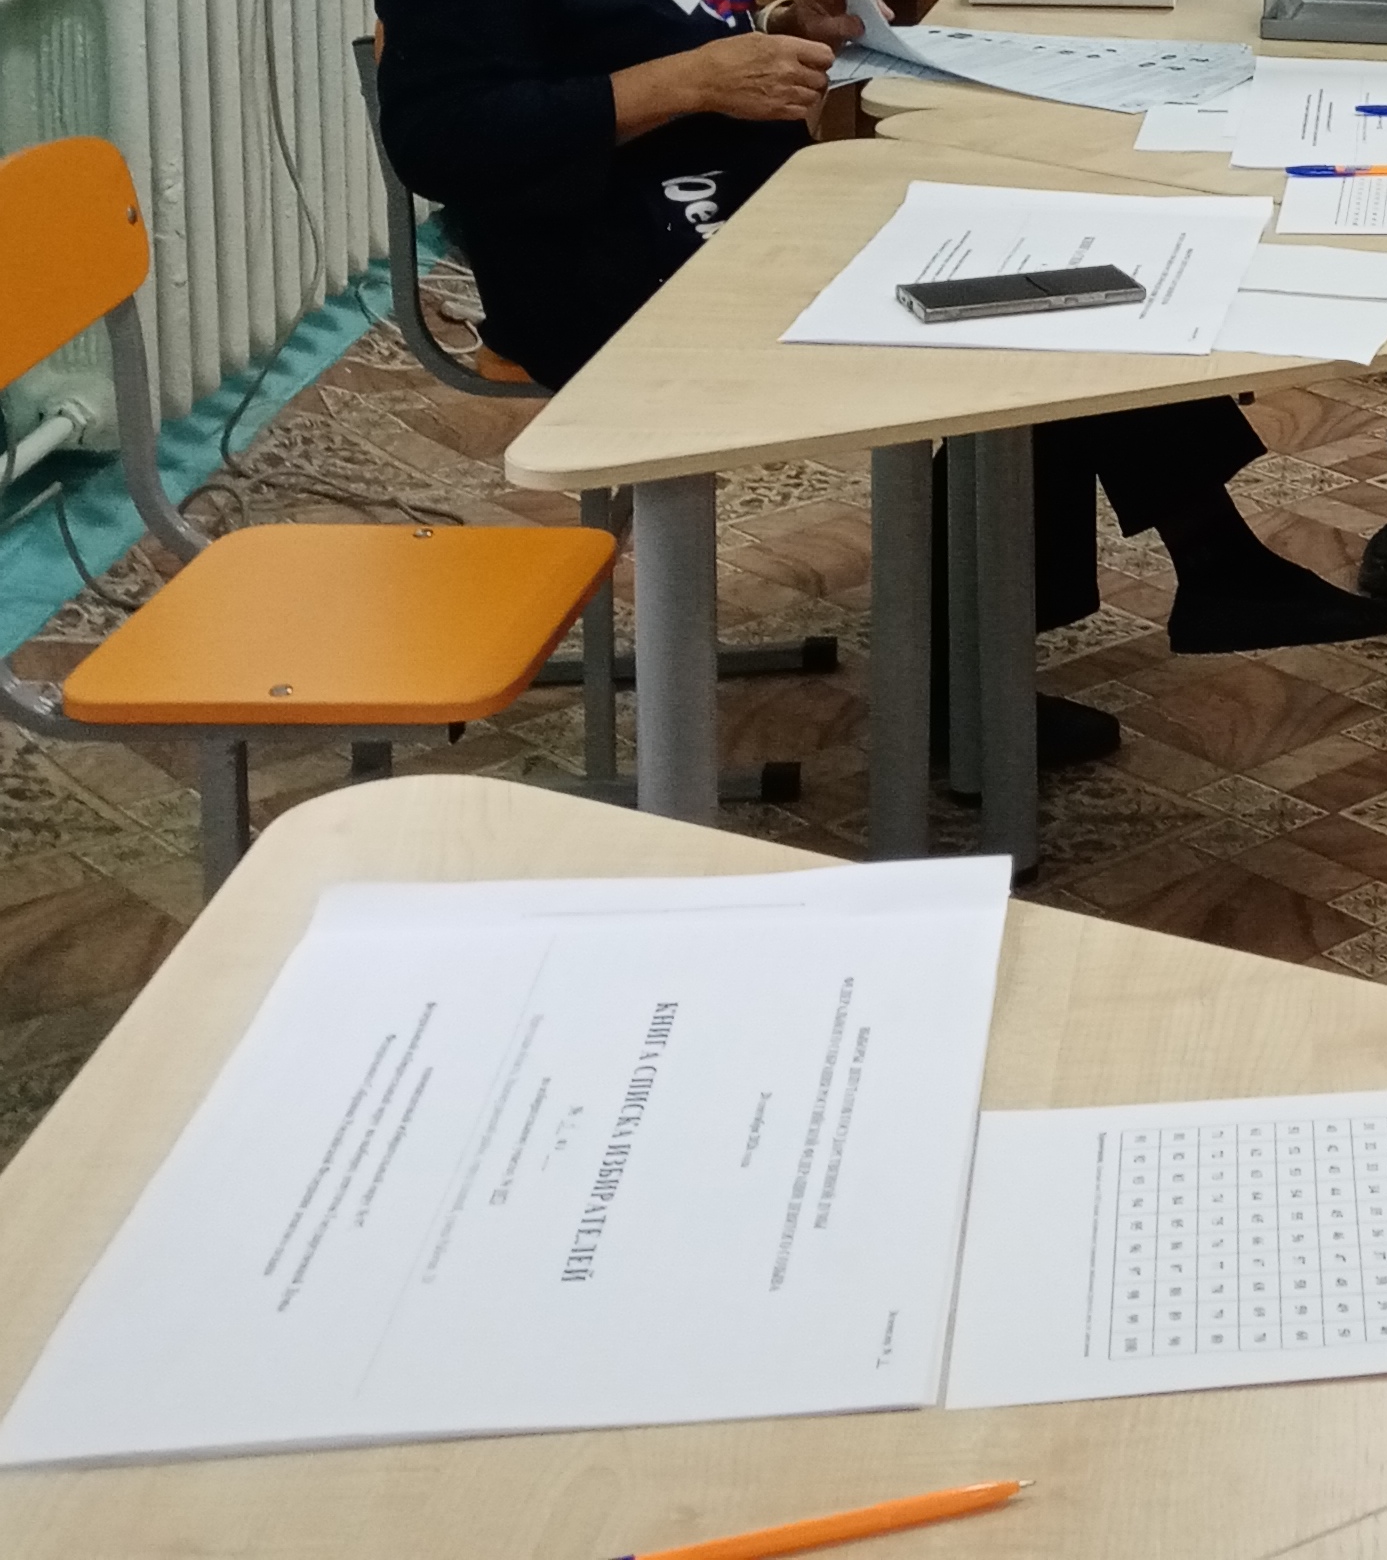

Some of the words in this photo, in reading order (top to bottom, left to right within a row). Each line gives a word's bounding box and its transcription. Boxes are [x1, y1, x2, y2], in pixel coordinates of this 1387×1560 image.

[639, 1002, 678, 1060] КНИГА
[612, 1065, 658, 1138] СПИСКА
[560, 1144, 631, 1282] ИЗБИРАТЕЛЕЙ
